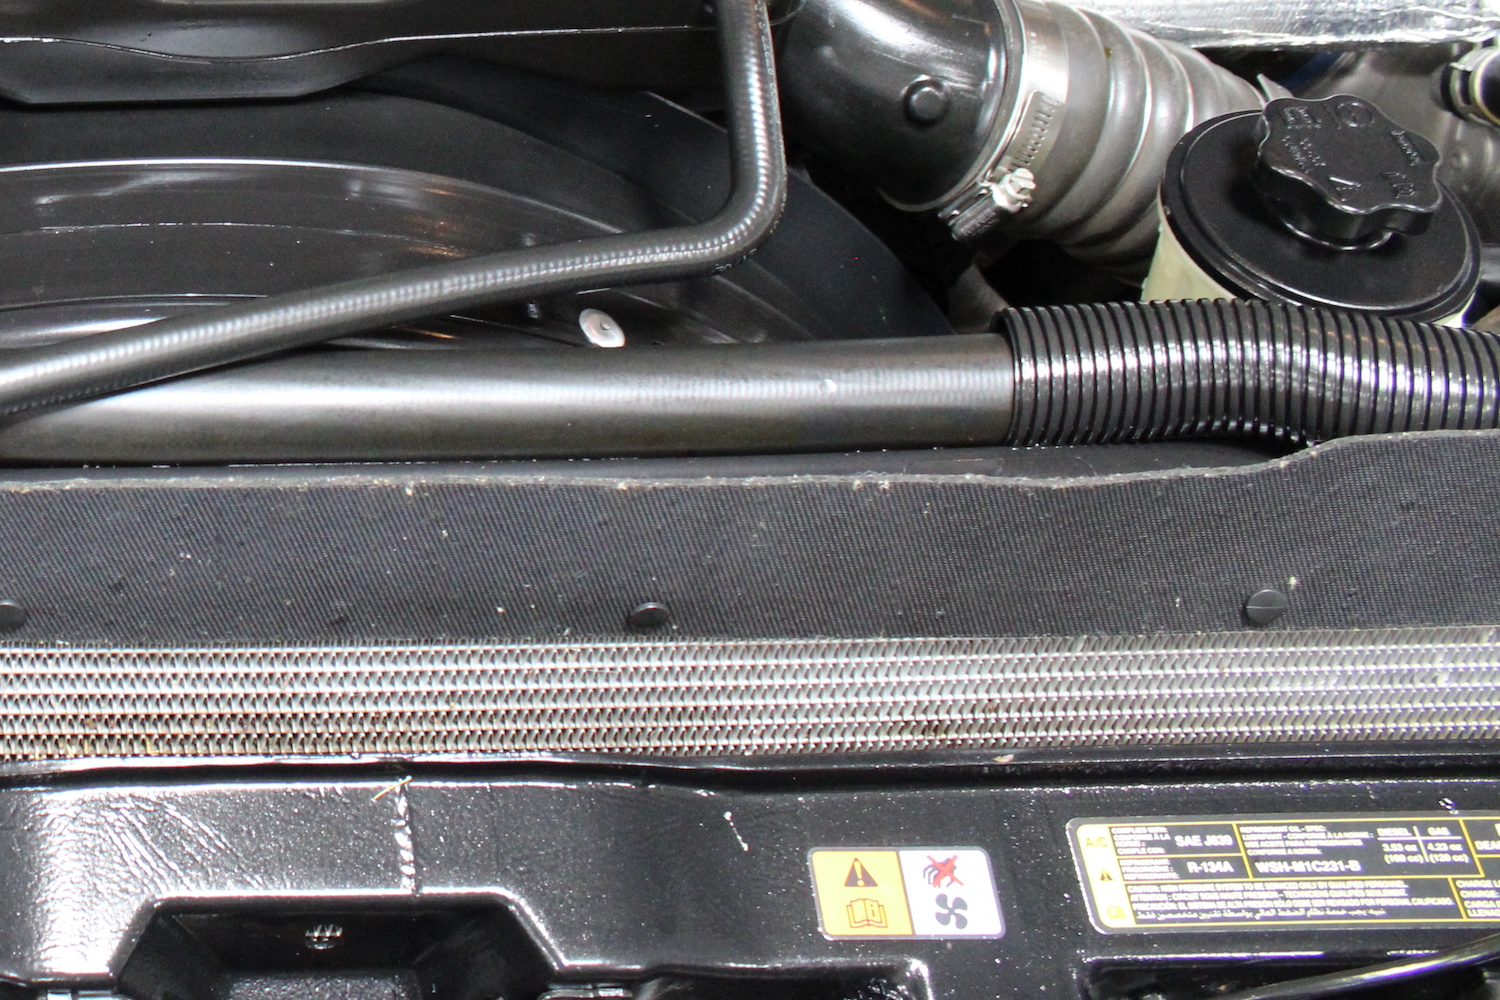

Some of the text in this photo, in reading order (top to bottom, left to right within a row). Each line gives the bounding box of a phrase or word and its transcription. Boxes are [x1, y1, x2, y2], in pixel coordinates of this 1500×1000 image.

[1376, 827, 1412, 836] DIESEL
[1427, 827, 1452, 836] GAS
[1174, 835, 1233, 847] SAE J639
[1187, 861, 1234, 873] R-134A
[1255, 860, 1361, 873] WSH-M1C231-B
